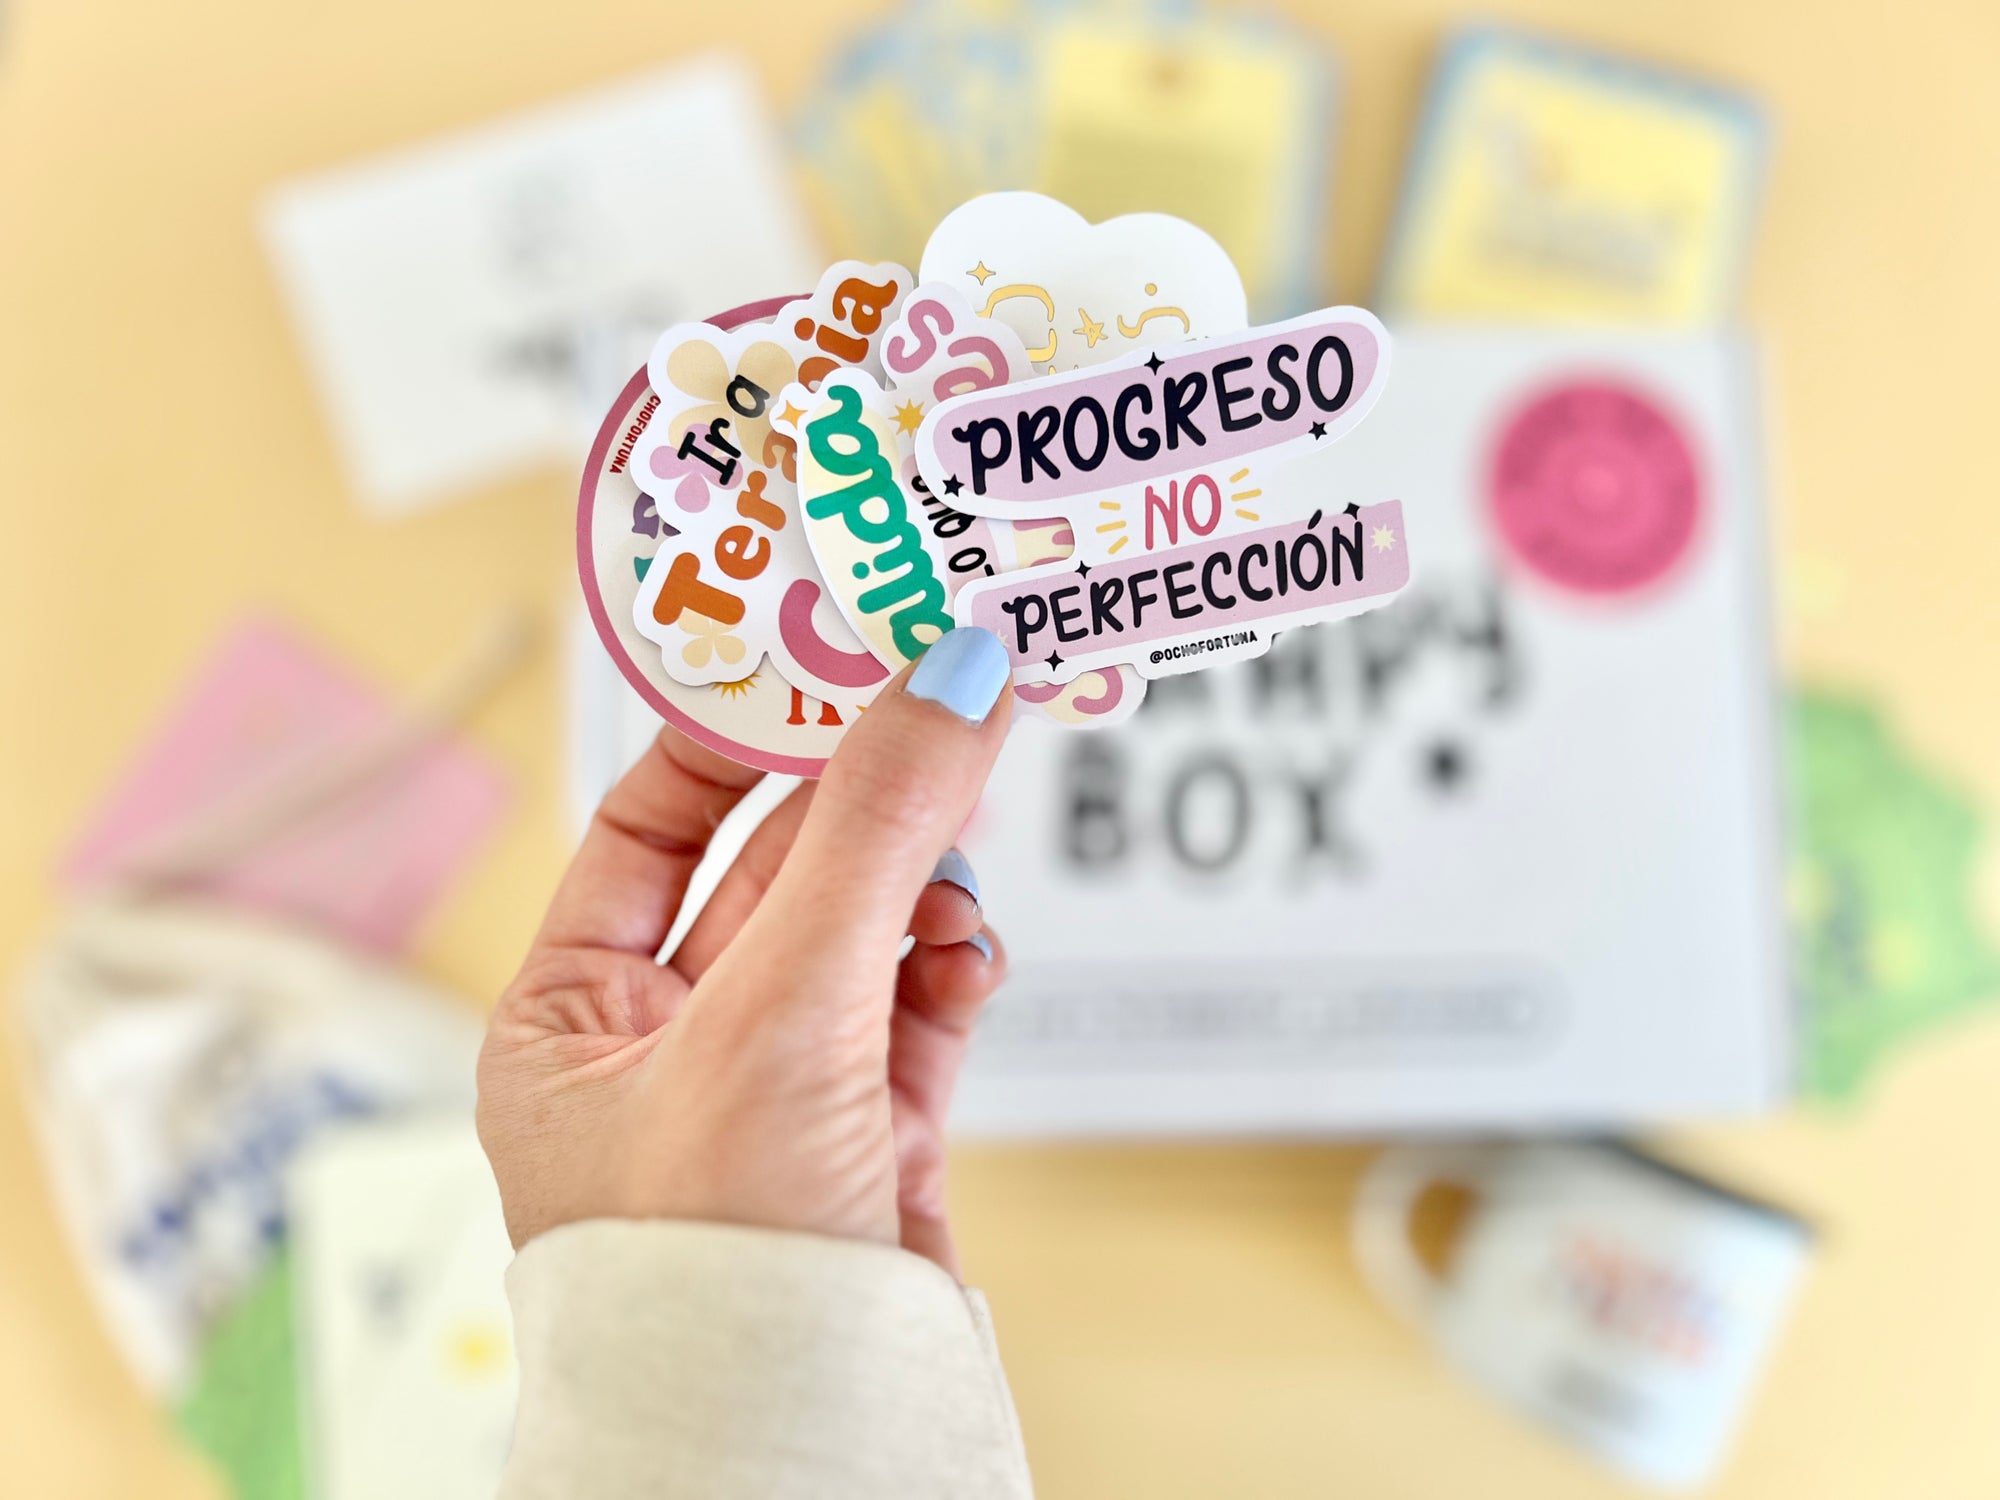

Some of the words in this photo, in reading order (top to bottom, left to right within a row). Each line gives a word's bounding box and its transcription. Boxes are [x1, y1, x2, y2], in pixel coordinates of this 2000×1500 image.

[652, 277, 898, 626] Teraia
[677, 417, 742, 486] Ir
[726, 374, 771, 419] a
[952, 335, 1354, 495] PROGRESO
[1144, 473, 1222, 551] NO
[1001, 509, 1364, 654] PERFECCIÓN
[1149, 630, 1258, 664] @OCHOFORTUNA
